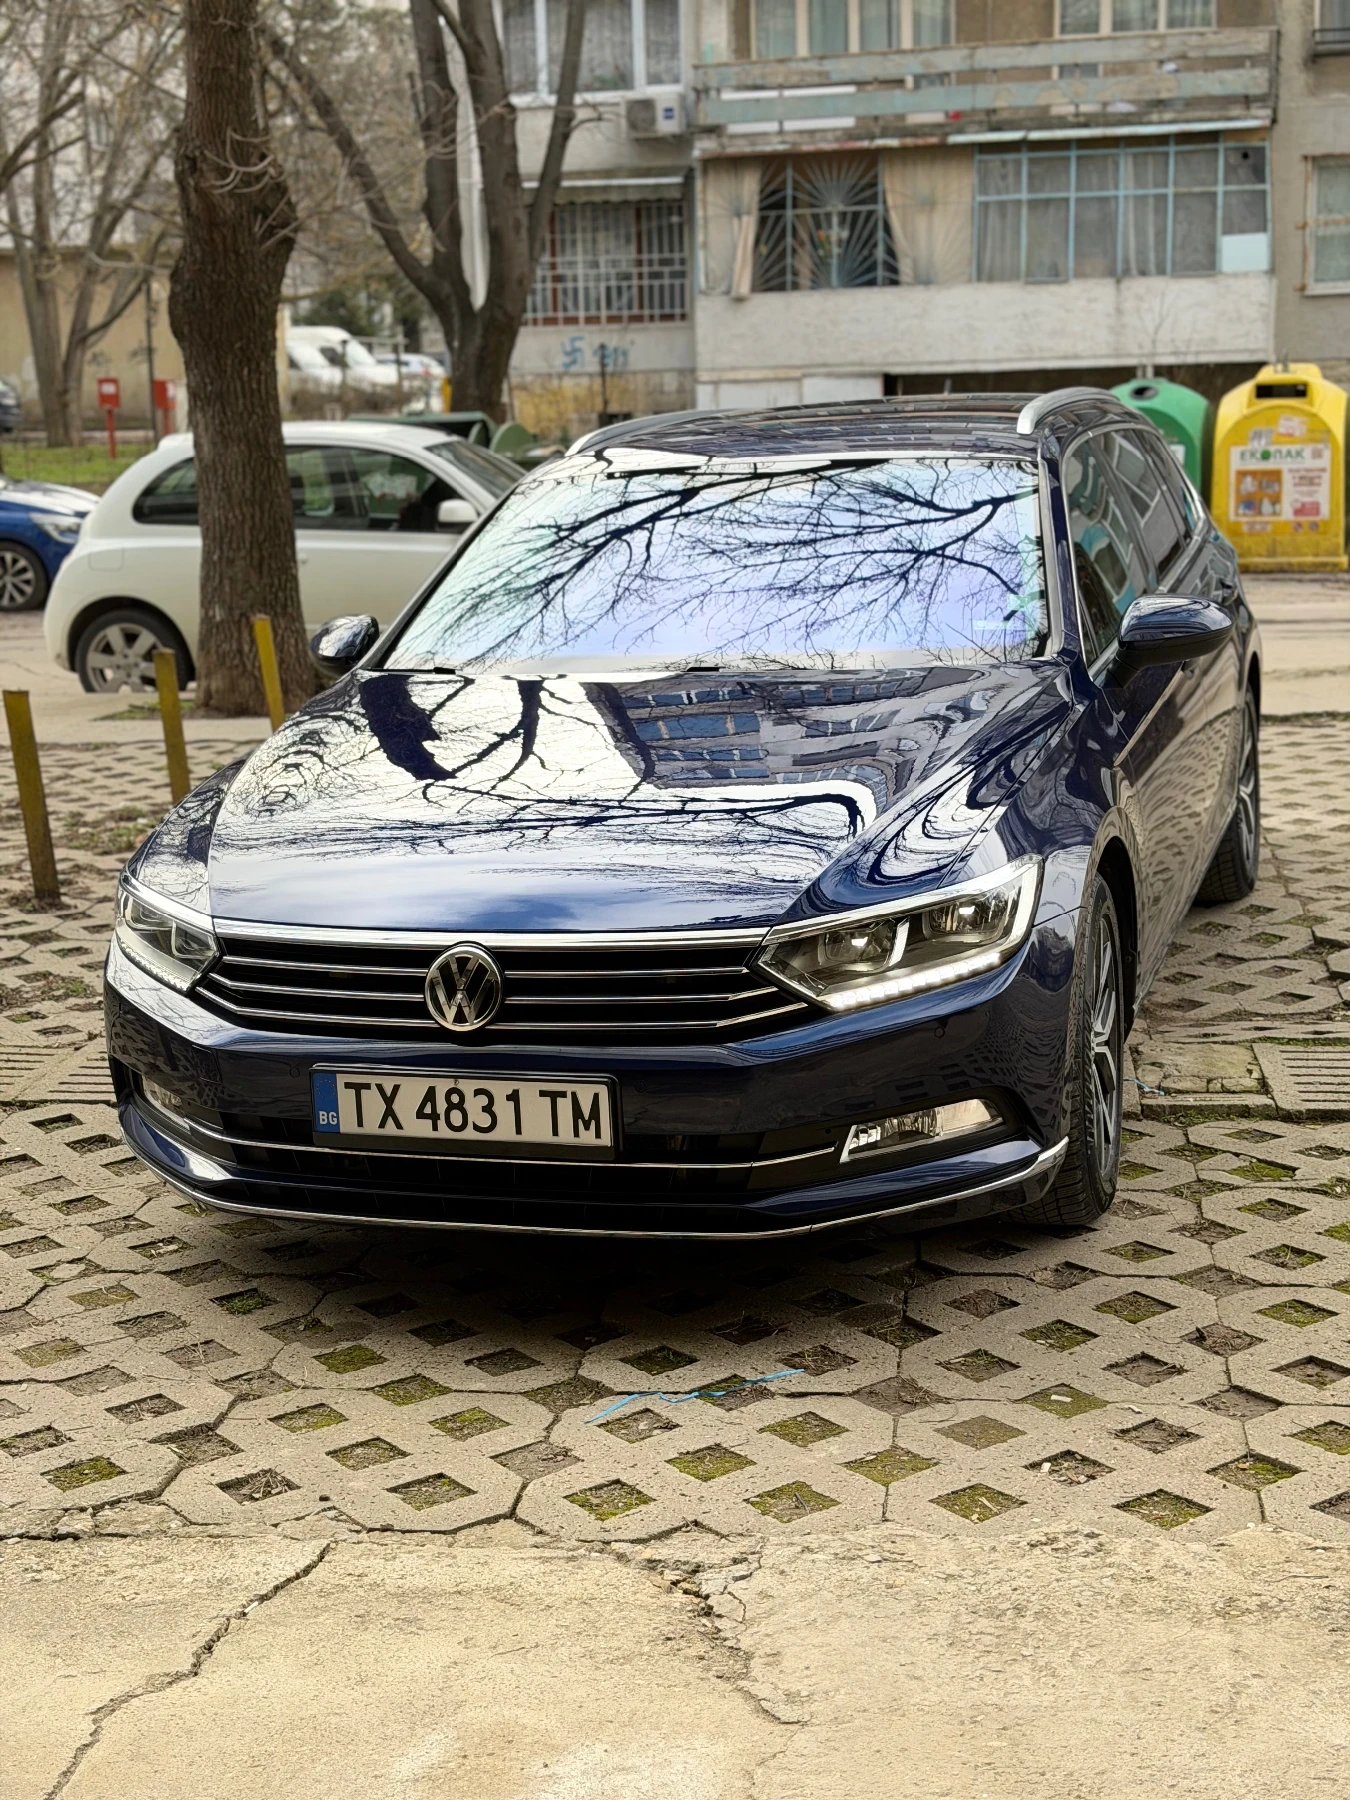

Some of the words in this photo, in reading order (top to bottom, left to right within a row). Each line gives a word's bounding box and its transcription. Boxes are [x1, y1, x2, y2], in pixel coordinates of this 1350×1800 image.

[428, 950, 500, 1029] VW
[318, 1110, 338, 1126] BG
[343, 1081, 404, 1131] TX
[415, 1085, 523, 1136] 4831
[538, 1089, 602, 1140] TM
